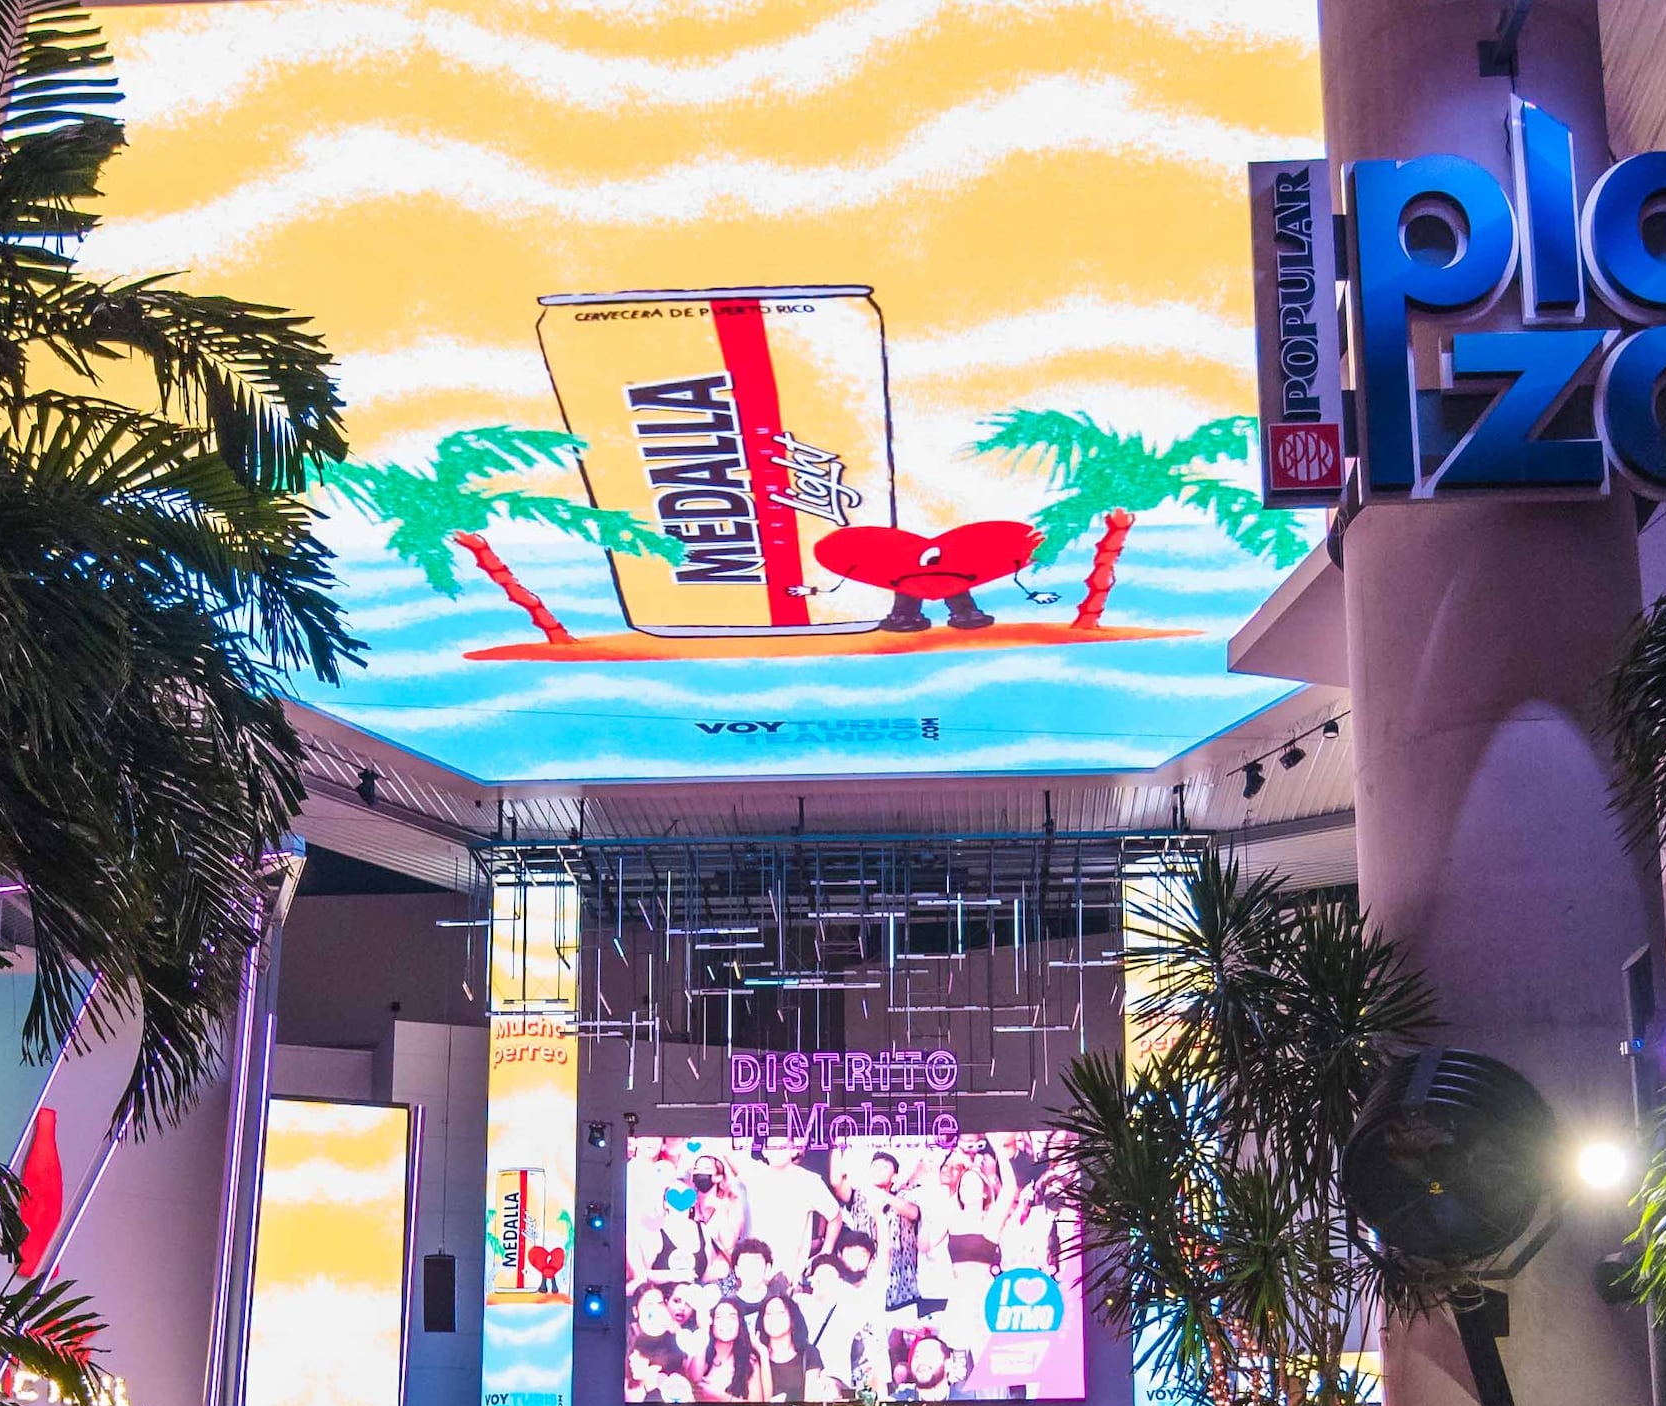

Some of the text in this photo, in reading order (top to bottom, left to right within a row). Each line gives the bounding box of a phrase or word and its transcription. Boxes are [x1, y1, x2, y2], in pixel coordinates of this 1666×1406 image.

[574, 304, 815, 322] CERVECERA DE PUERTO RICO
[1275, 165, 1322, 423] POPULAR
[624, 371, 766, 585] MEDALLA
[770, 432, 862, 526] Light
[494, 1018, 568, 1040] Mucho
[494, 1043, 568, 1070] perreo
[731, 1050, 958, 1093] DISTRITO
[501, 1191, 520, 1268] MEDALLA
